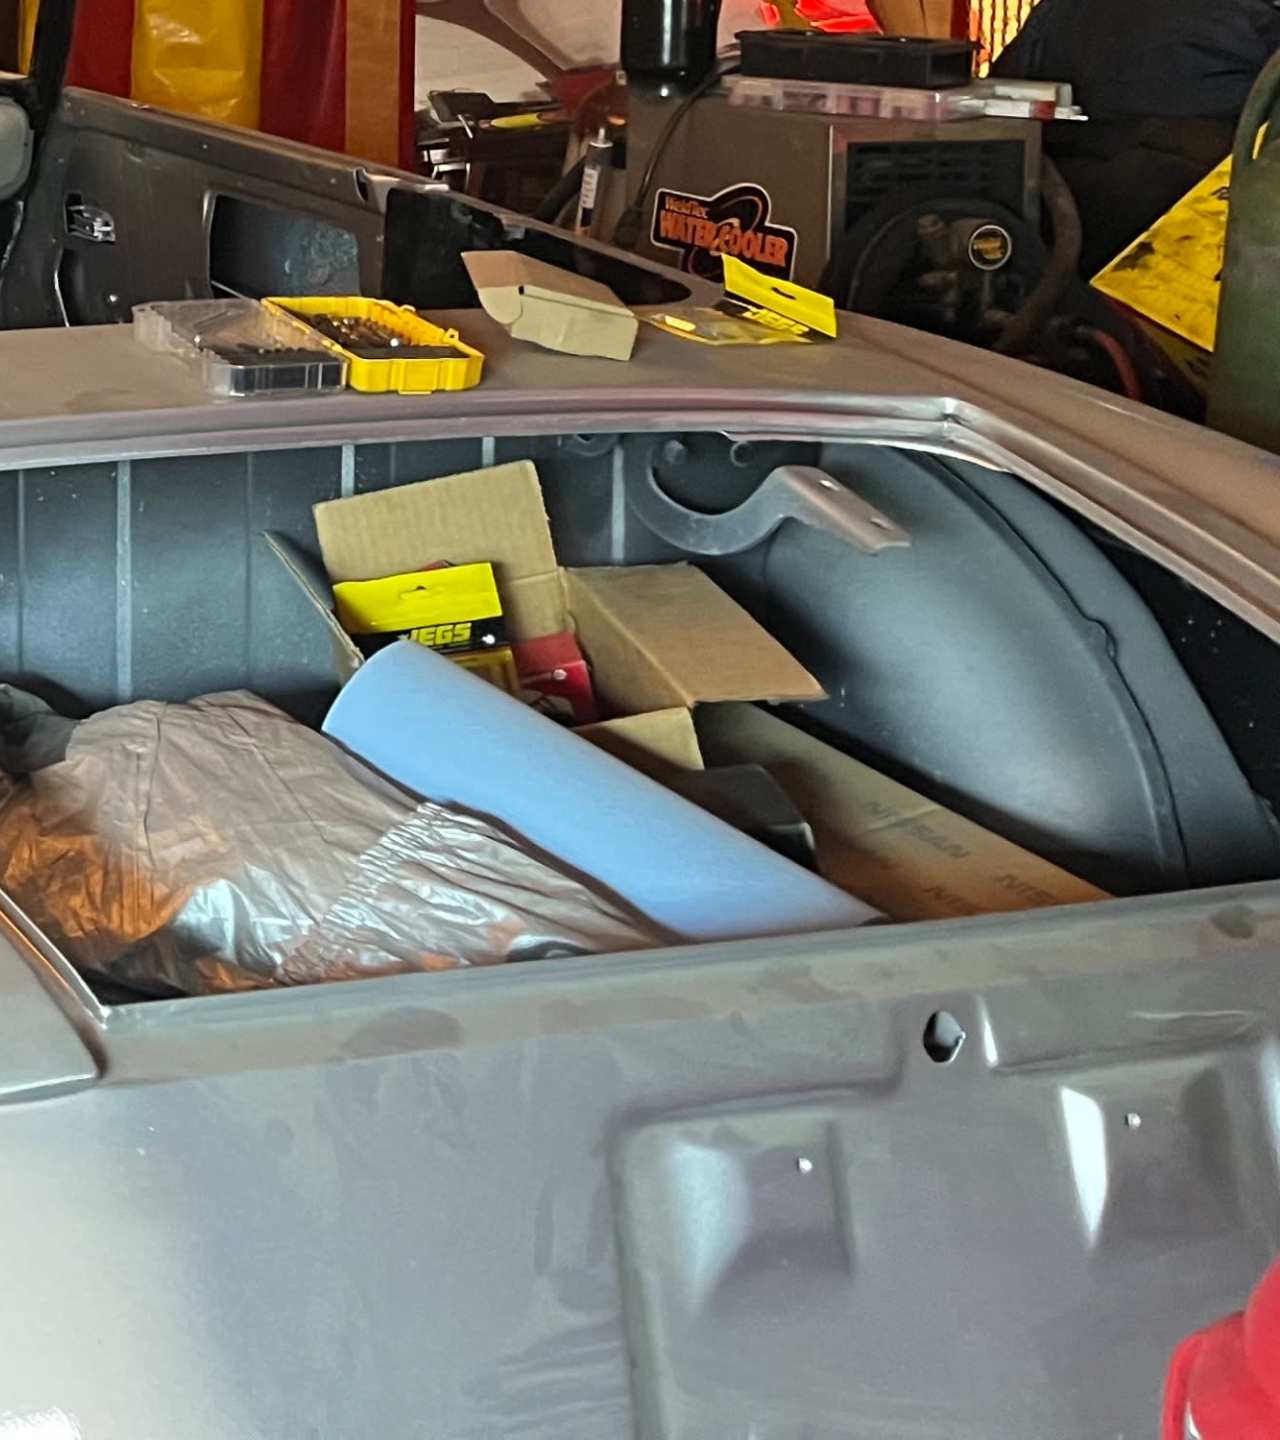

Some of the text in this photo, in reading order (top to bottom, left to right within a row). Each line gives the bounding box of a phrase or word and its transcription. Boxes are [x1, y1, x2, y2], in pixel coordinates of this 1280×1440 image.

[659, 210, 789, 268] WATER COOLER
[408, 622, 473, 647] JEGS
